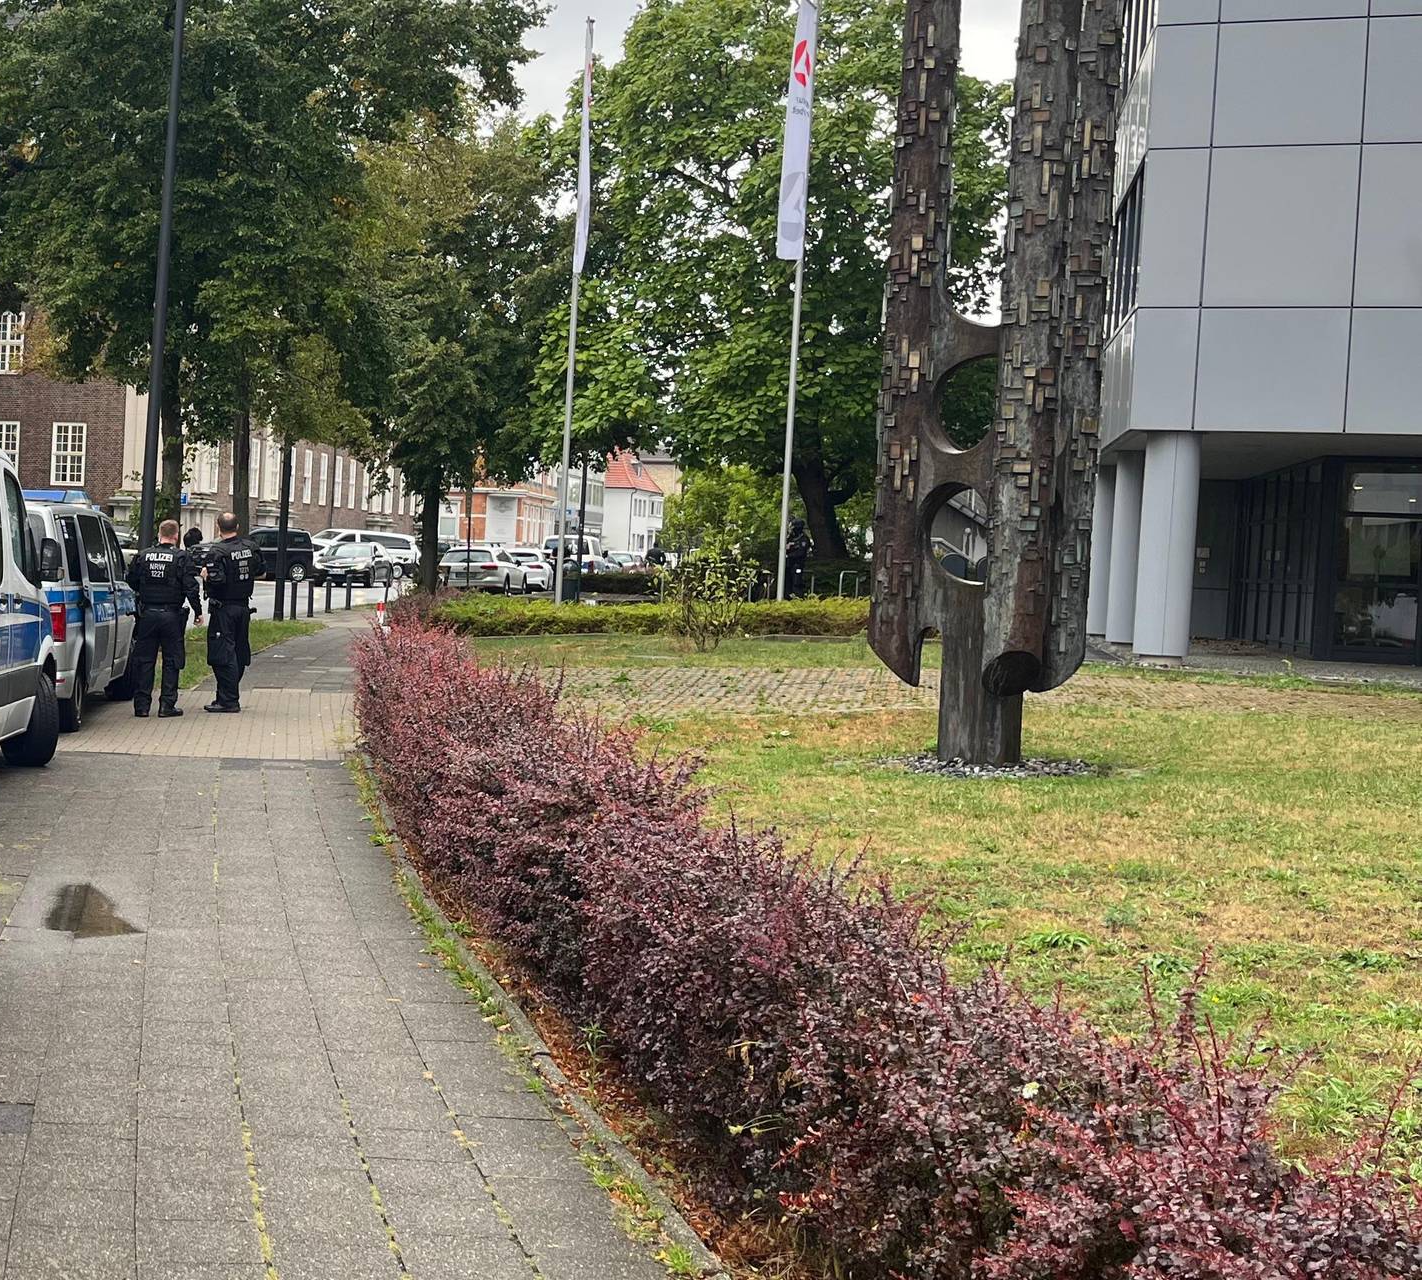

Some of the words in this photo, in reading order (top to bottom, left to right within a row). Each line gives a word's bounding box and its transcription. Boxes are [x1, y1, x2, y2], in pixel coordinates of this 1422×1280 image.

[145, 552, 174, 562] POLIZEI
[231, 549, 253, 561] POLIZEI
[149, 562, 166, 571] NRW
